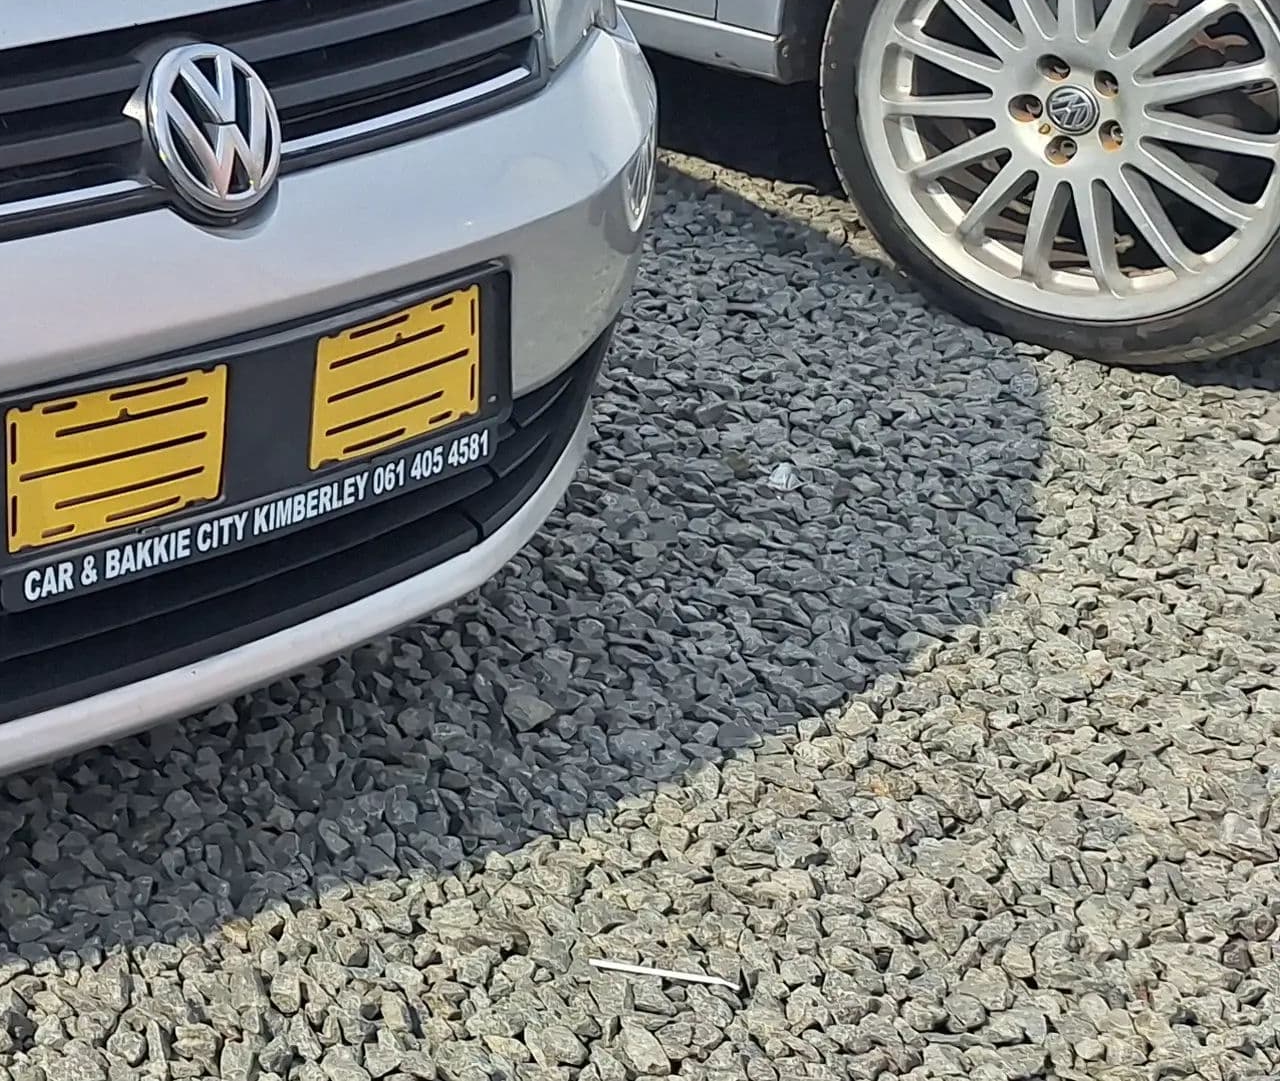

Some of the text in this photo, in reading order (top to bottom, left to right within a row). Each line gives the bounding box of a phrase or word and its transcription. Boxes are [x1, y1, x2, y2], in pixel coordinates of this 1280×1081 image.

[24, 428, 491, 602] CAR & BAKKIE CITY KIMBERLEY 061 405 4581
